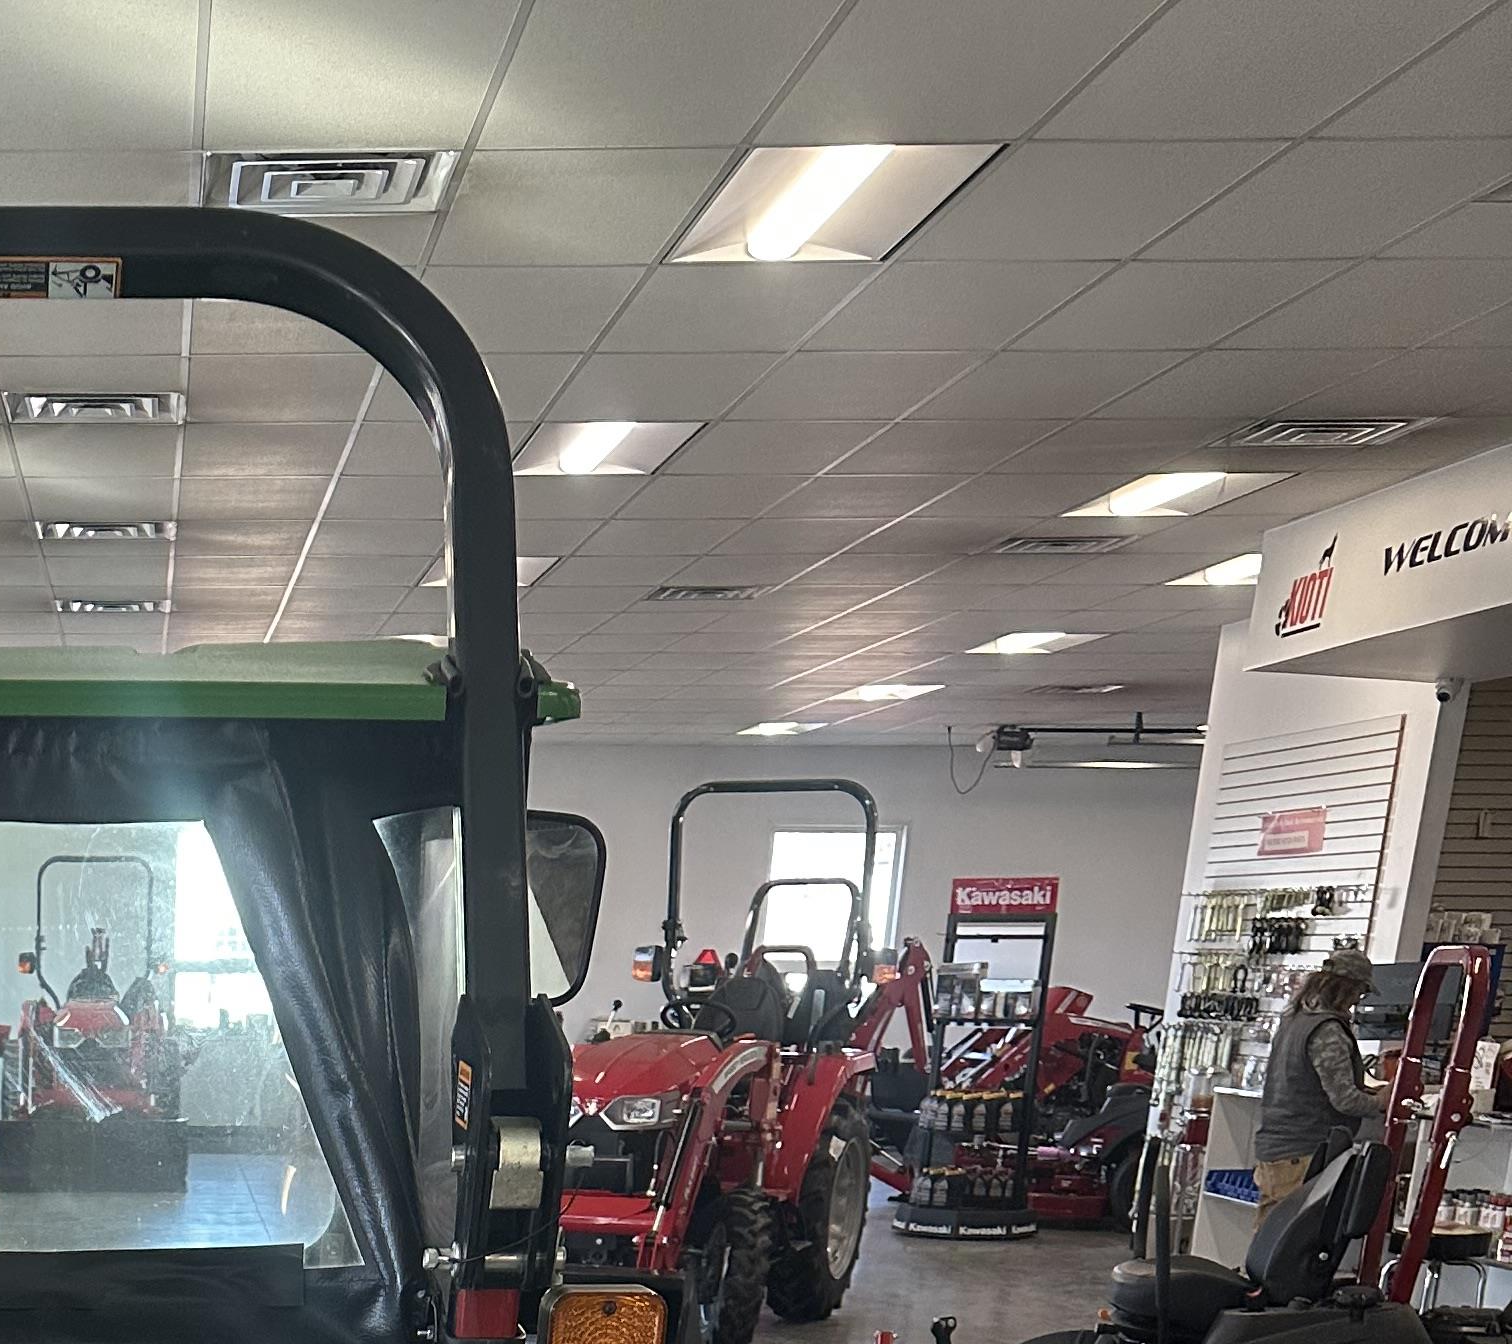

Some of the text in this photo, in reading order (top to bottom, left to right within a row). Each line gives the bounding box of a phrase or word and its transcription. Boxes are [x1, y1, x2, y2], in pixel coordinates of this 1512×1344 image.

[1287, 566, 1334, 628] KIOTI
[955, 886, 1052, 906] Kawasaki
[958, 1226, 1007, 1236] Kawasaki
